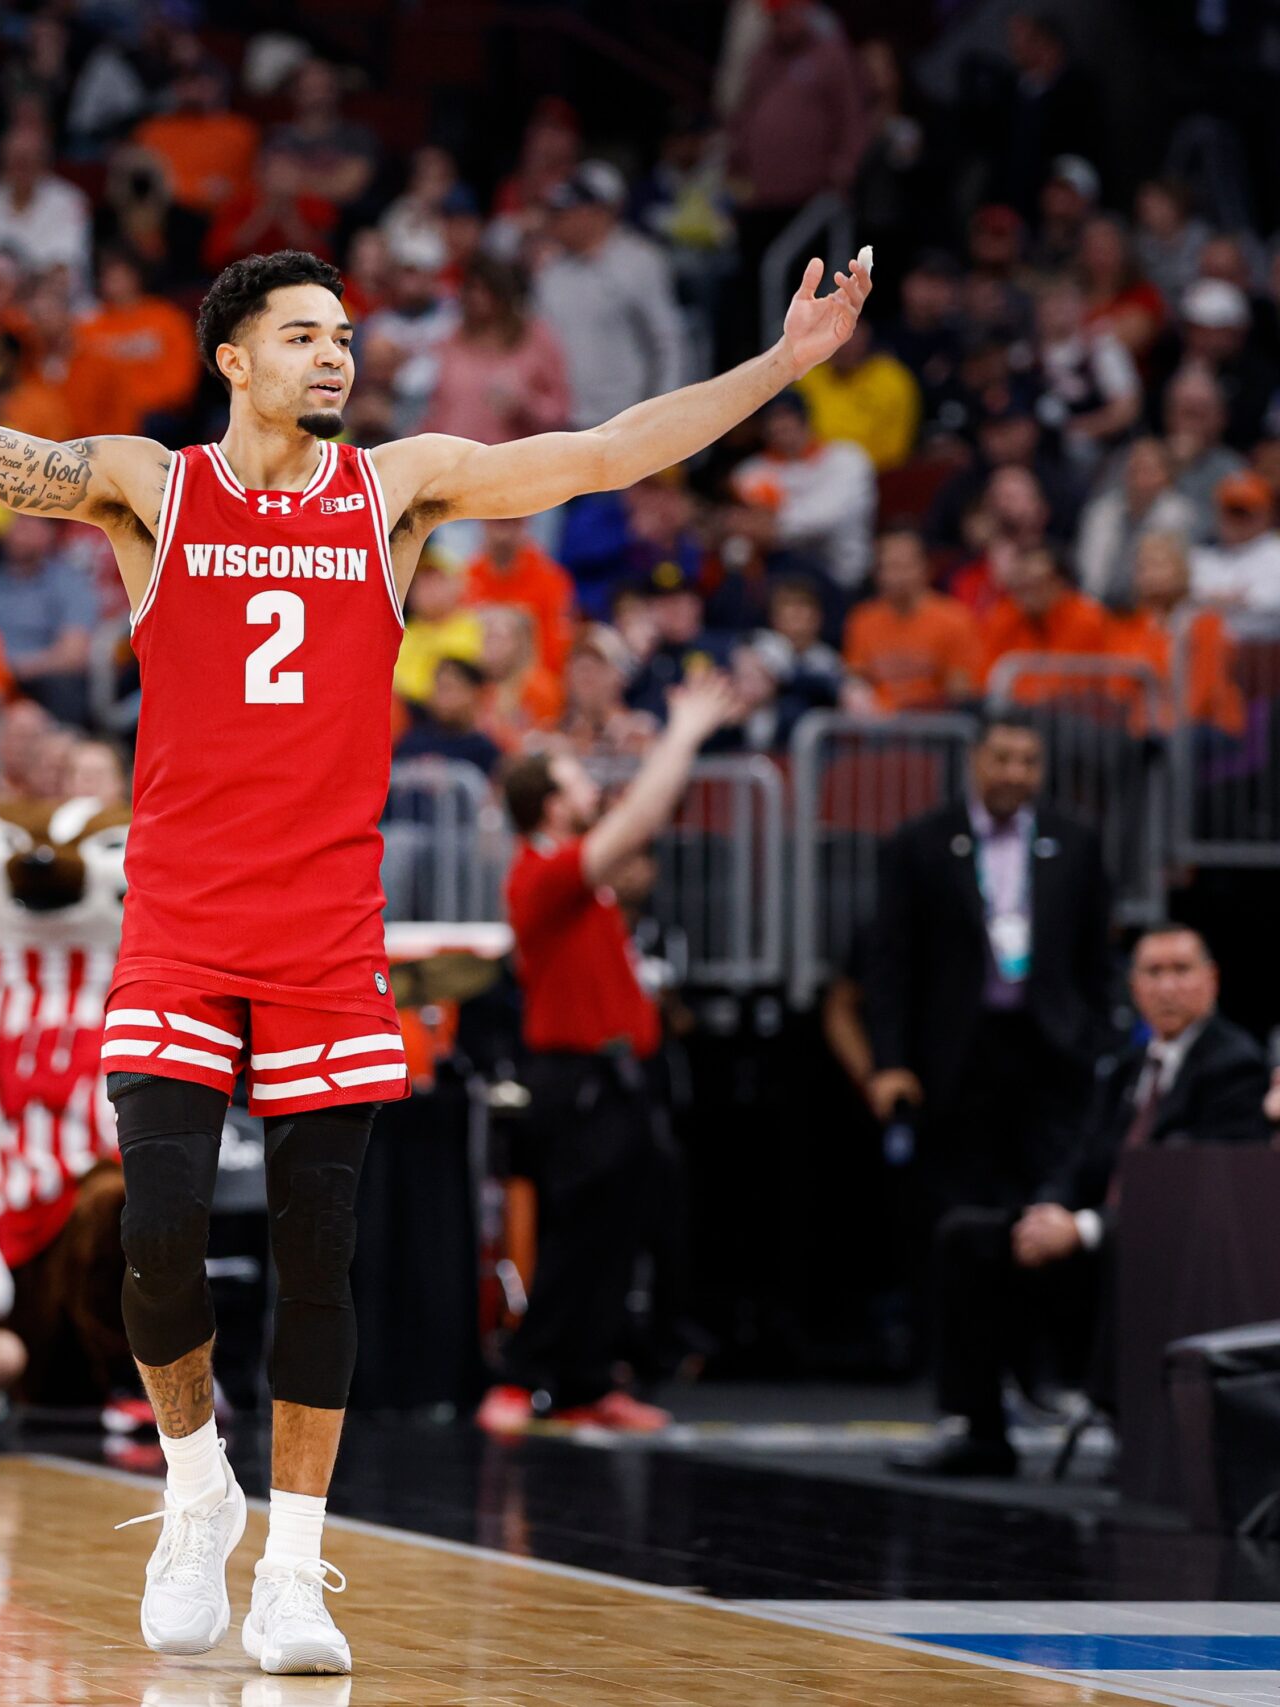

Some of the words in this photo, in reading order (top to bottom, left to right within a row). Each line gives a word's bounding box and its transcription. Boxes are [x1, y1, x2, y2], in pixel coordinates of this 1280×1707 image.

[23, 444, 36, 461] by
[26, 461, 39, 478] of
[43, 450, 85, 484] God
[183, 544, 368, 582] WISCONSIN
[245, 590, 305, 704] 2
